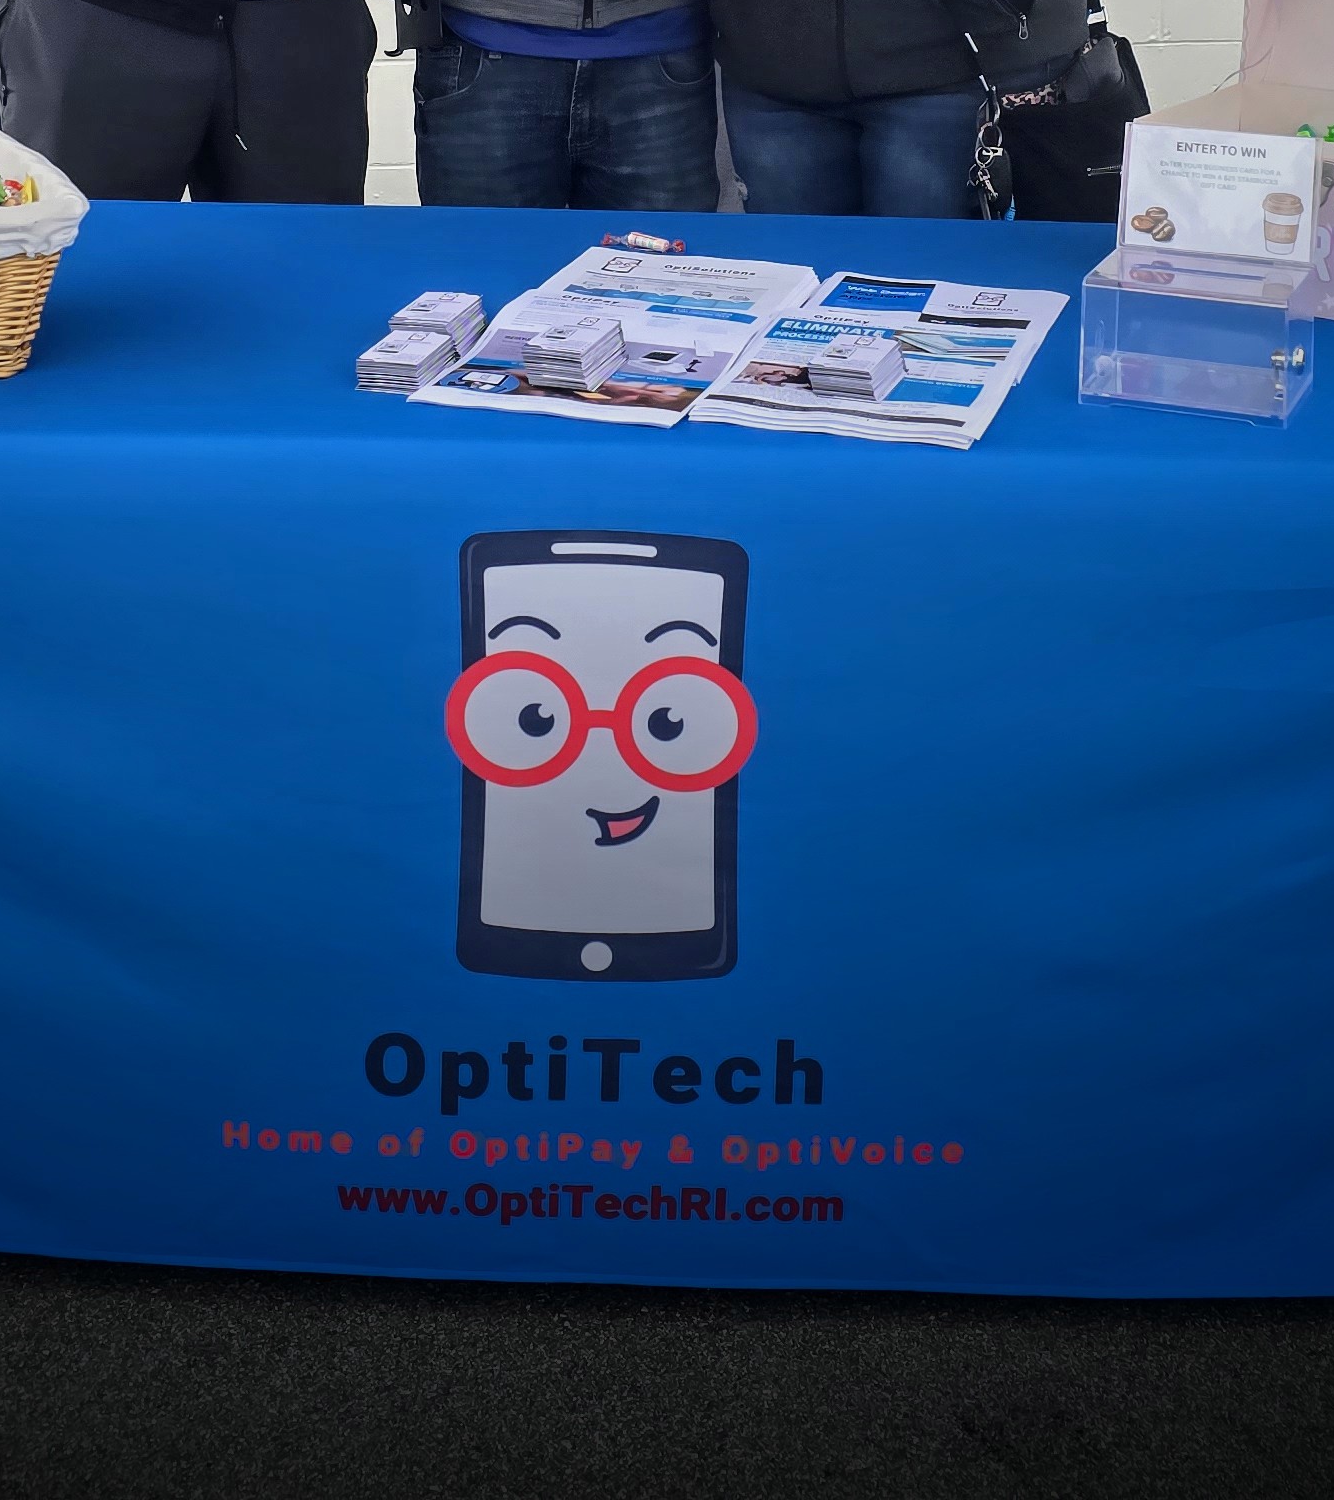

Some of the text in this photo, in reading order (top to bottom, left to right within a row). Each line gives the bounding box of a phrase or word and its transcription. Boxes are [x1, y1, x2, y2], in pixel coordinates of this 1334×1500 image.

[1176, 141, 1267, 158] ENTER TO WIN
[781, 320, 886, 338] ELIMINATE
[365, 1032, 823, 1115] OptiTech
[222, 1120, 965, 1172] Home of OptiPay & OptiVoice
[337, 1182, 845, 1226] www.OptiTechRI.com
